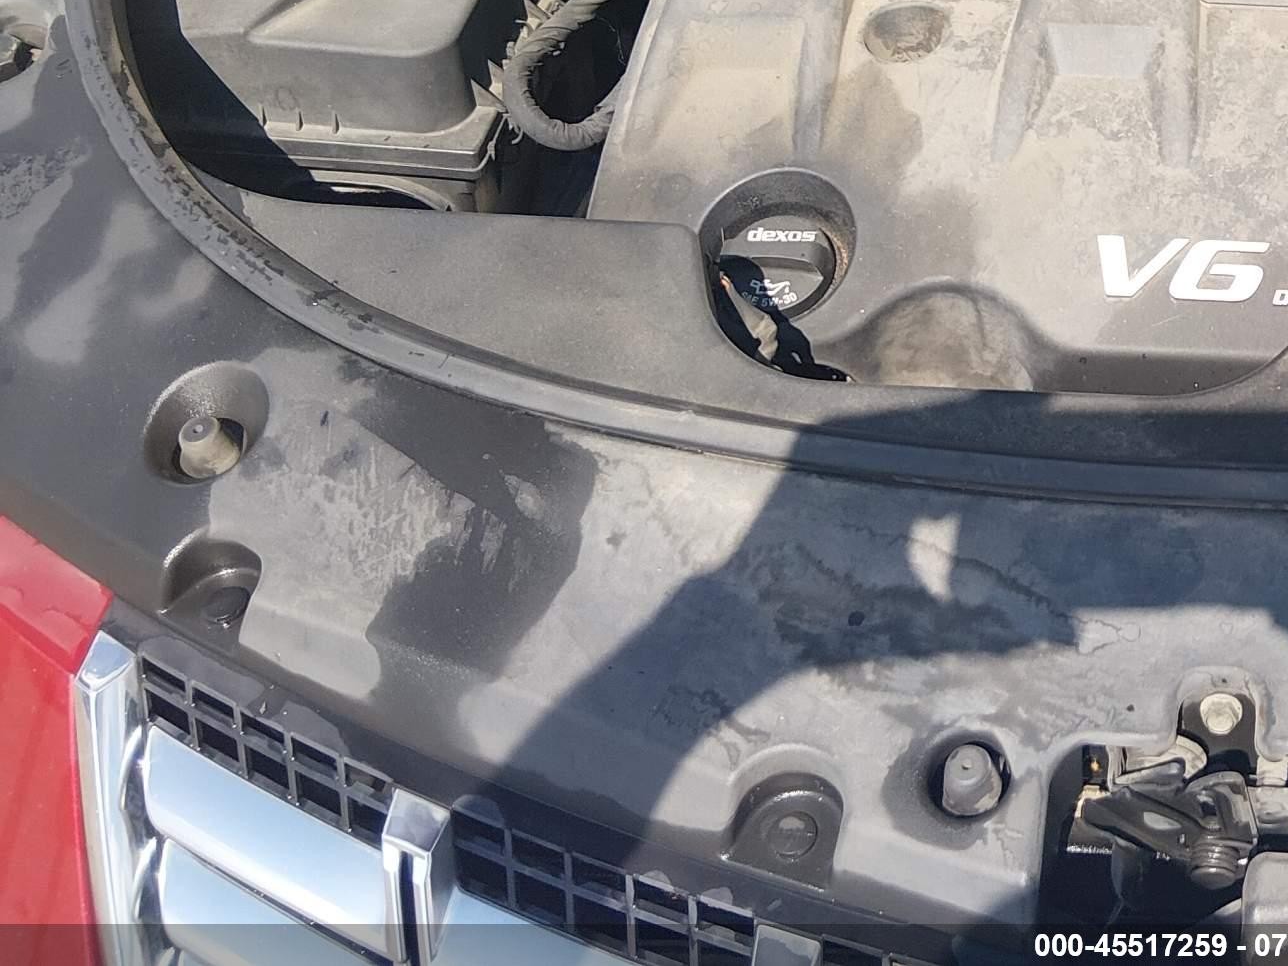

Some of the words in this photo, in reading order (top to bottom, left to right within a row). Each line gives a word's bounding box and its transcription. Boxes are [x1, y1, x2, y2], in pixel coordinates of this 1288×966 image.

[747, 227, 817, 242] dexos
[1096, 234, 1271, 301] V6
[761, 292, 798, 307] 5W-30
